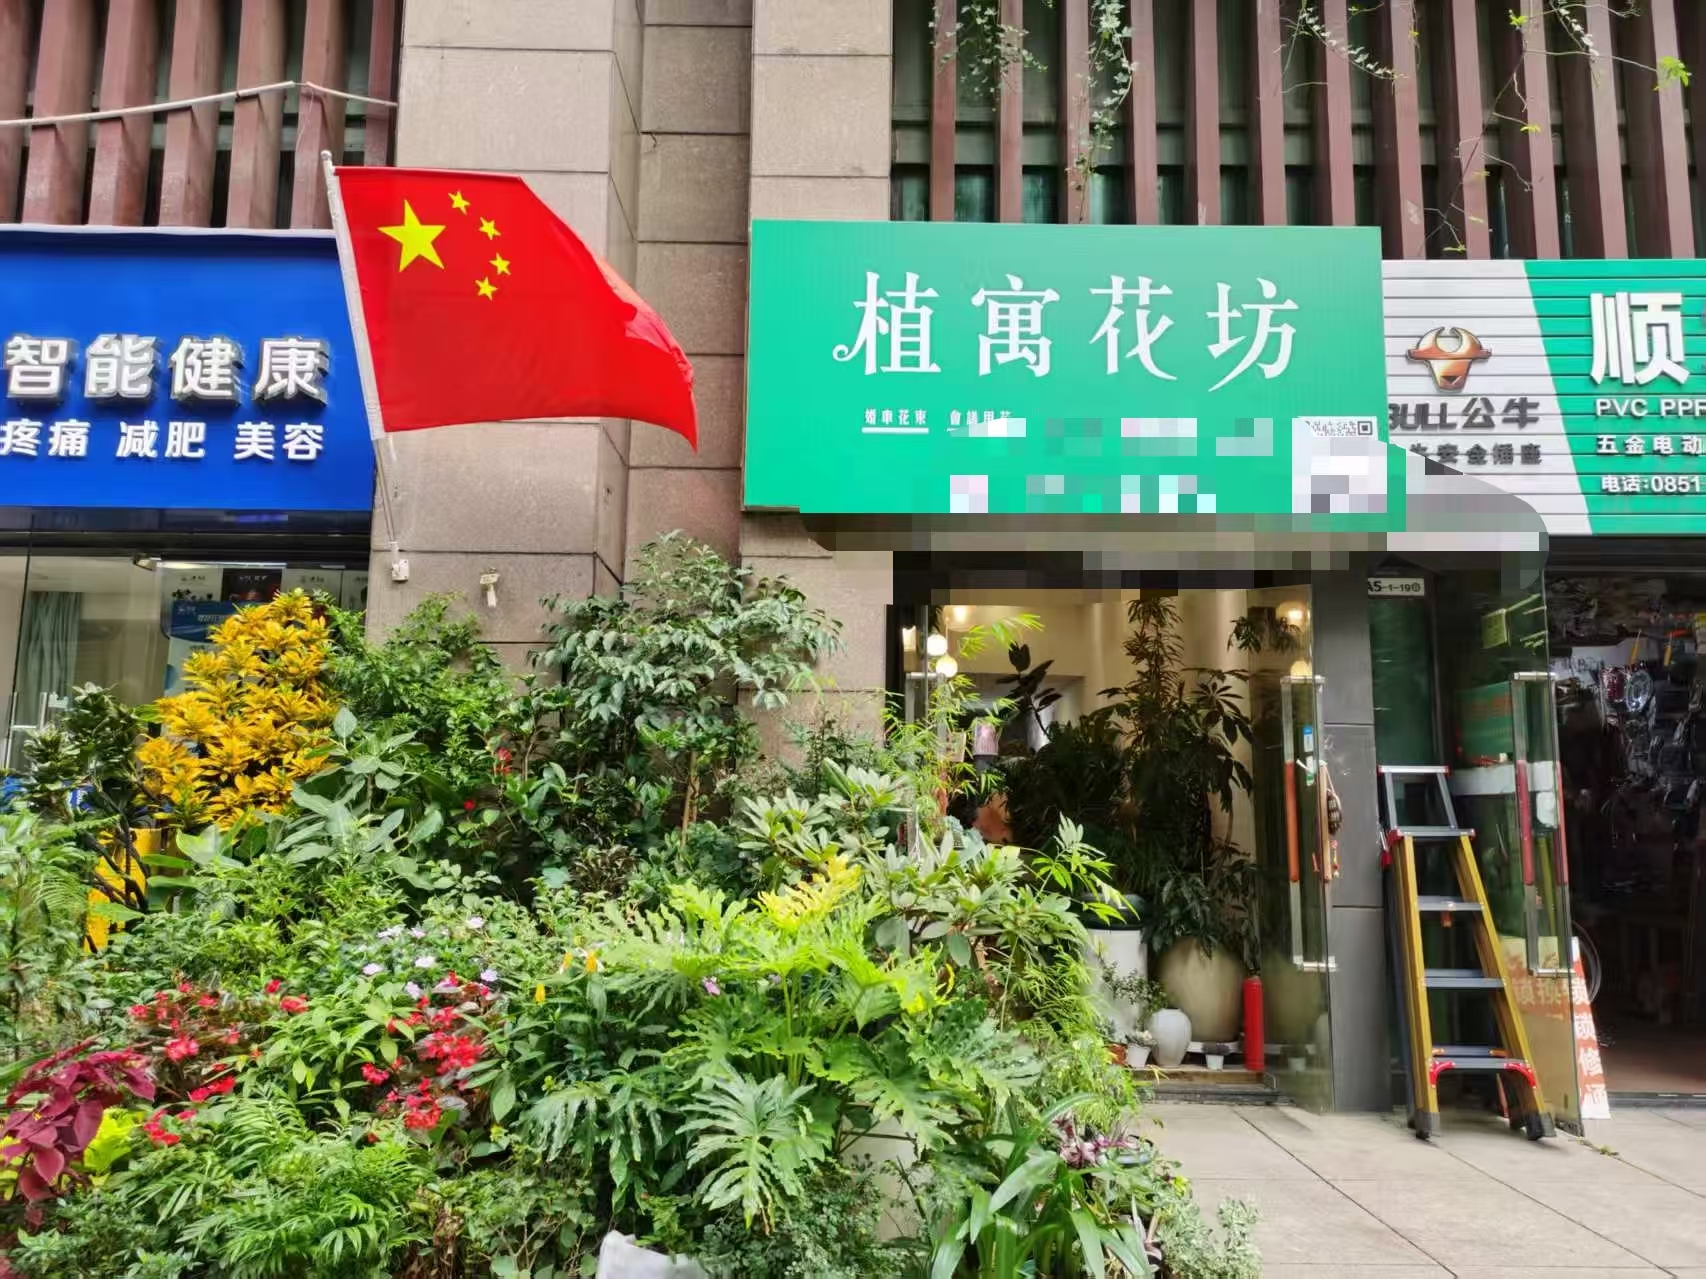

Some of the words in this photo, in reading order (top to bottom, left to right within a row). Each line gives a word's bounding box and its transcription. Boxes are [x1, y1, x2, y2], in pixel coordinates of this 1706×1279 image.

[832, 271, 1300, 392] 植寓花坊
[1590, 292, 1690, 385] 顺
[5, 334, 329, 405] 智能健康
[1596, 399, 1648, 417] PVC
[0, 419, 91, 457] 疼痛
[116, 421, 207, 458] 减肥
[234, 421, 324, 461] 美容
[1597, 435, 1704, 454] 五金电动
